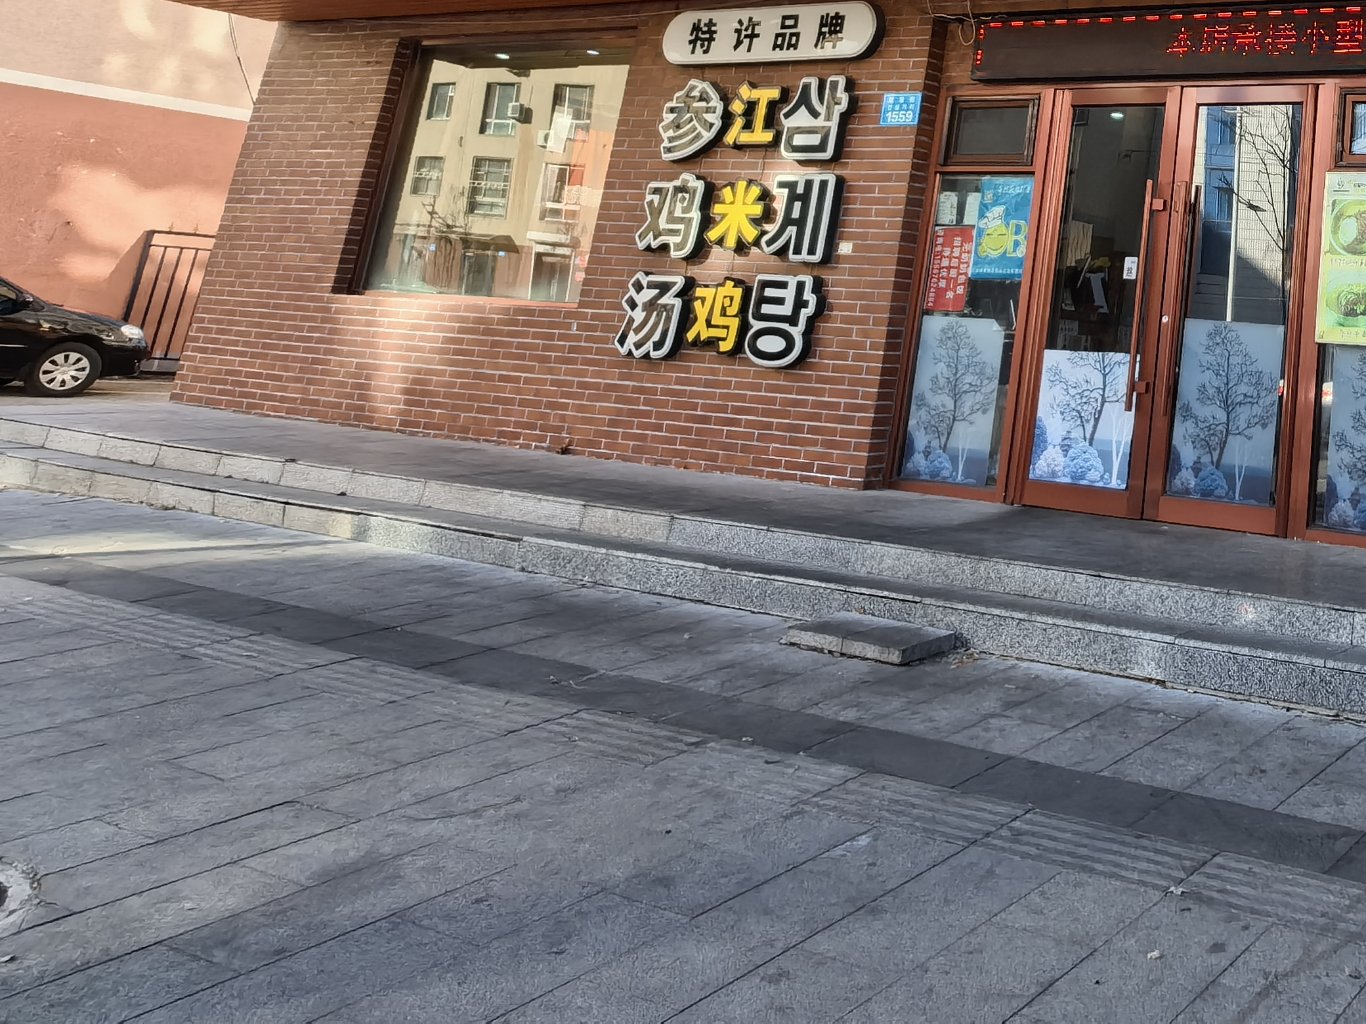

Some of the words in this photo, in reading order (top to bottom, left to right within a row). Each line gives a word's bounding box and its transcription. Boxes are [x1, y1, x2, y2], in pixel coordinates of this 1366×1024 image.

[688, 12, 847, 54] 特许品牌
[886, 111, 913, 123] 1559
